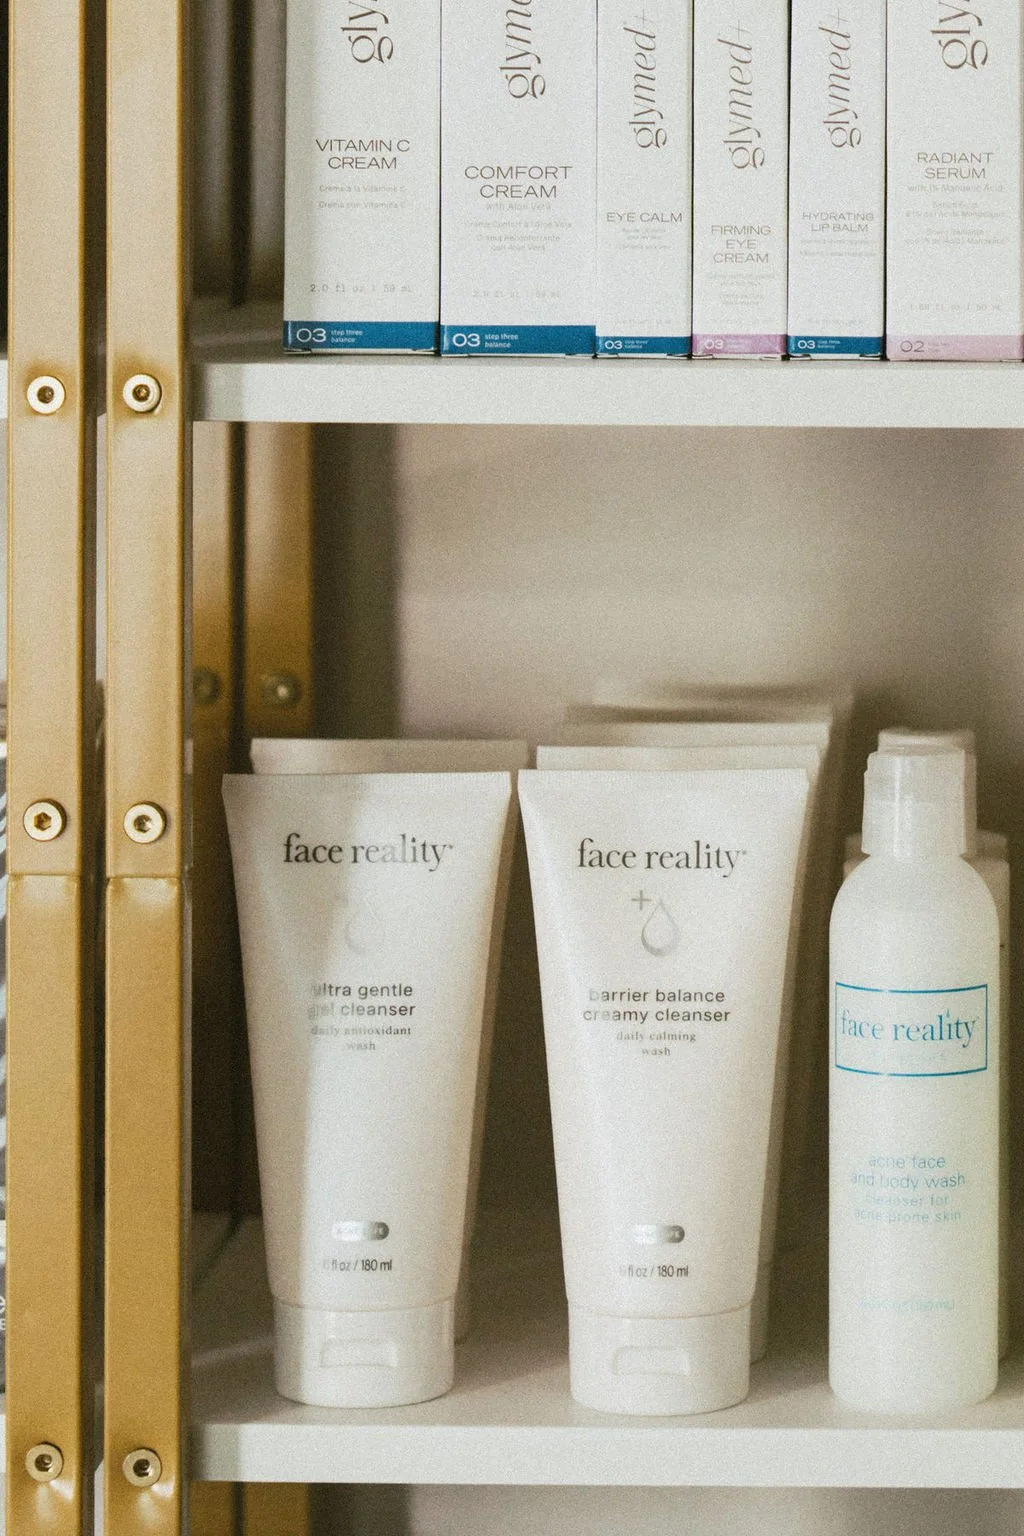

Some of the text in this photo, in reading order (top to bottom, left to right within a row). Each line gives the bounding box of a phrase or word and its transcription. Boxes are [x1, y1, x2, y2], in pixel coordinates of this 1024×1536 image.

[316, 139, 410, 153] VITAMIN C
[327, 156, 397, 170] CREAM
[917, 151, 994, 164] RADIANT
[464, 165, 573, 180] COMFORT
[924, 167, 987, 180] SERUM
[479, 184, 557, 199] CREAM
[606, 212, 683, 223] EYE CALM
[711, 225, 772, 236] FIRMING
[726, 239, 757, 250] EYE
[713, 253, 769, 264] CREAM
[296, 328, 327, 342] 03
[452, 333, 481, 347] 03
[604, 340, 623, 350] 03
[797, 340, 816, 349] 03
[900, 340, 925, 353] 02
[283, 832, 449, 872] face reality
[577, 837, 741, 878] face reality
[357, 982, 413, 1000] gentle
[589, 987, 726, 1003] barrier balance
[340, 1002, 416, 1017] cleanser
[583, 1008, 731, 1025] creamy cleanser
[841, 1007, 977, 1048] face reality
[649, 1031, 697, 1043] calming
[642, 1046, 671, 1057] wash
[925, 1172, 966, 1188] wash
